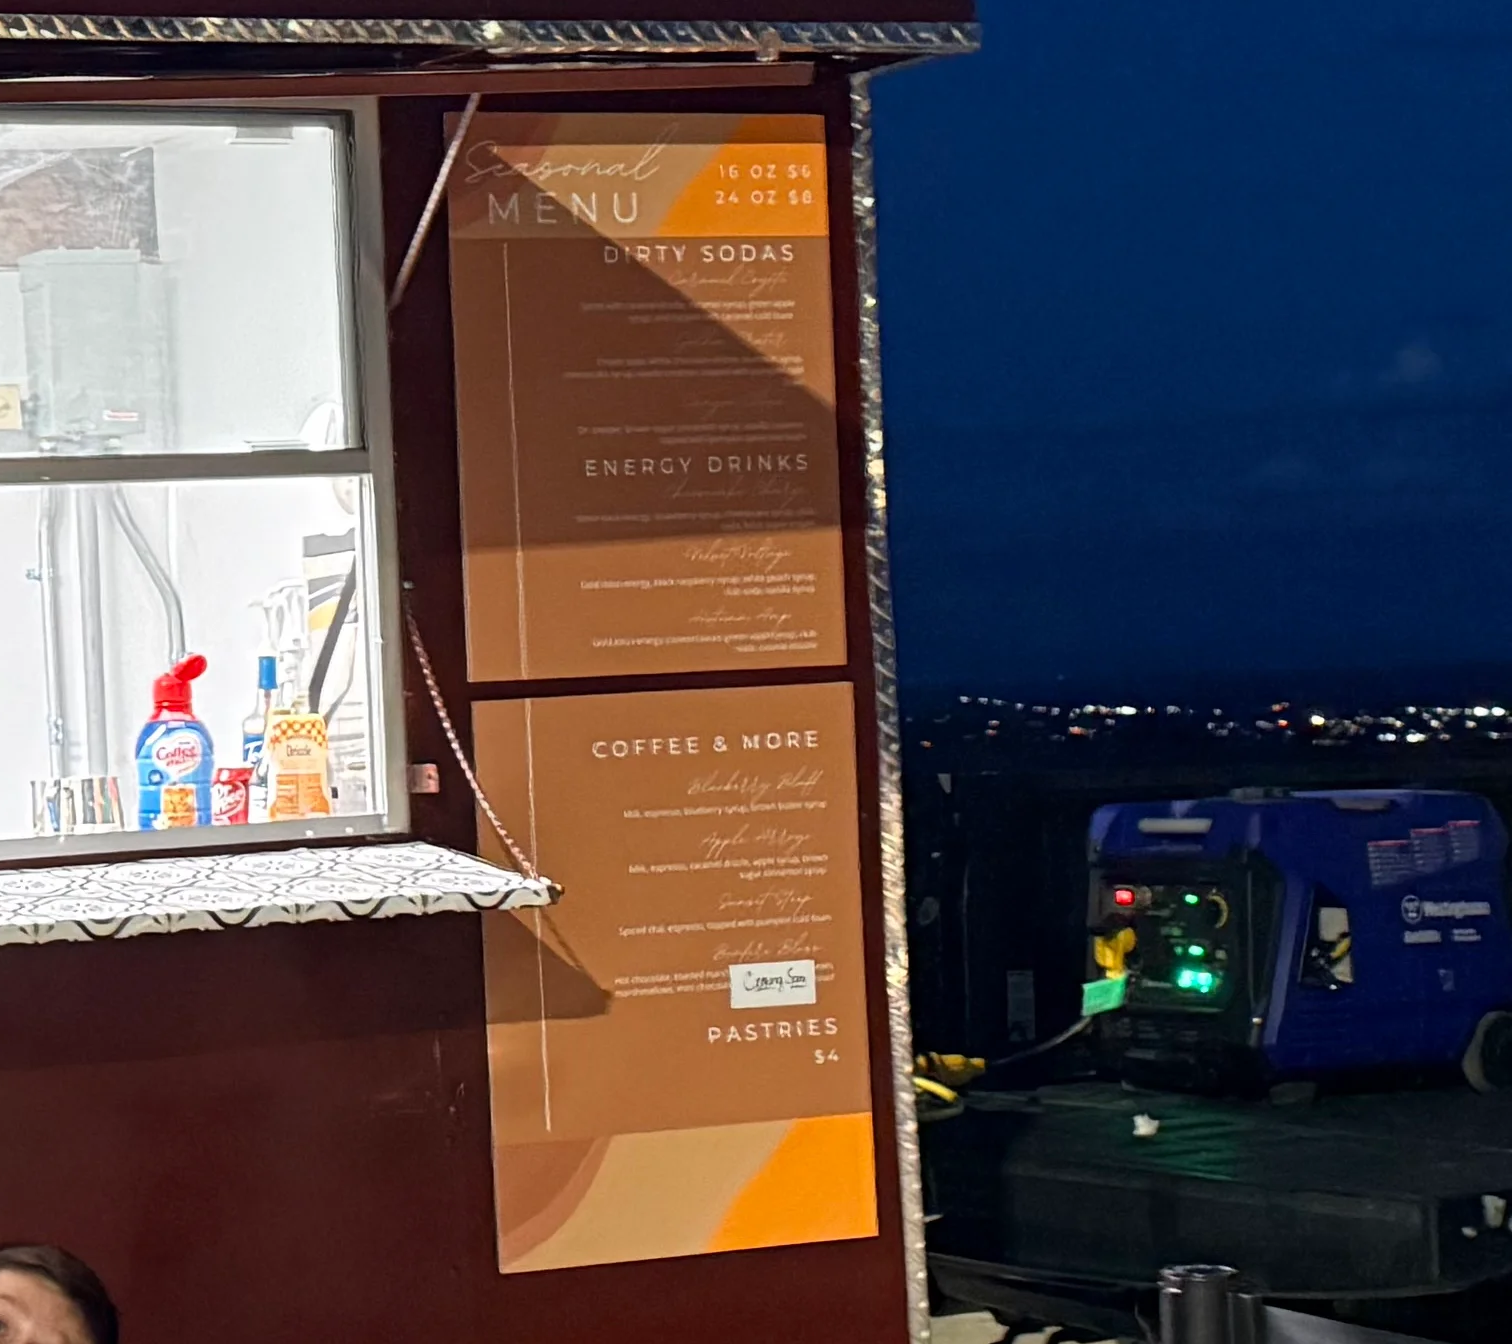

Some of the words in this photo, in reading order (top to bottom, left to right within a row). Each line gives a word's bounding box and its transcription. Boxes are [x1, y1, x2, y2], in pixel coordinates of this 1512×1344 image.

[464, 124, 680, 182] Seasonal
[719, 164, 741, 180] 16
[750, 164, 777, 180] OZ
[488, 192, 638, 225] MENU
[715, 189, 741, 205] 24
[751, 190, 777, 205] OZ
[604, 244, 687, 264] DIRTY
[701, 244, 795, 263] SODAS
[585, 456, 692, 477] ENERGY
[708, 453, 809, 474] DRINKS
[591, 736, 701, 760] COFFEE
[712, 735, 728, 753] &
[742, 730, 820, 751] MORE
[708, 1017, 838, 1044] PASTRIES
[812, 1048, 840, 1065] $4
